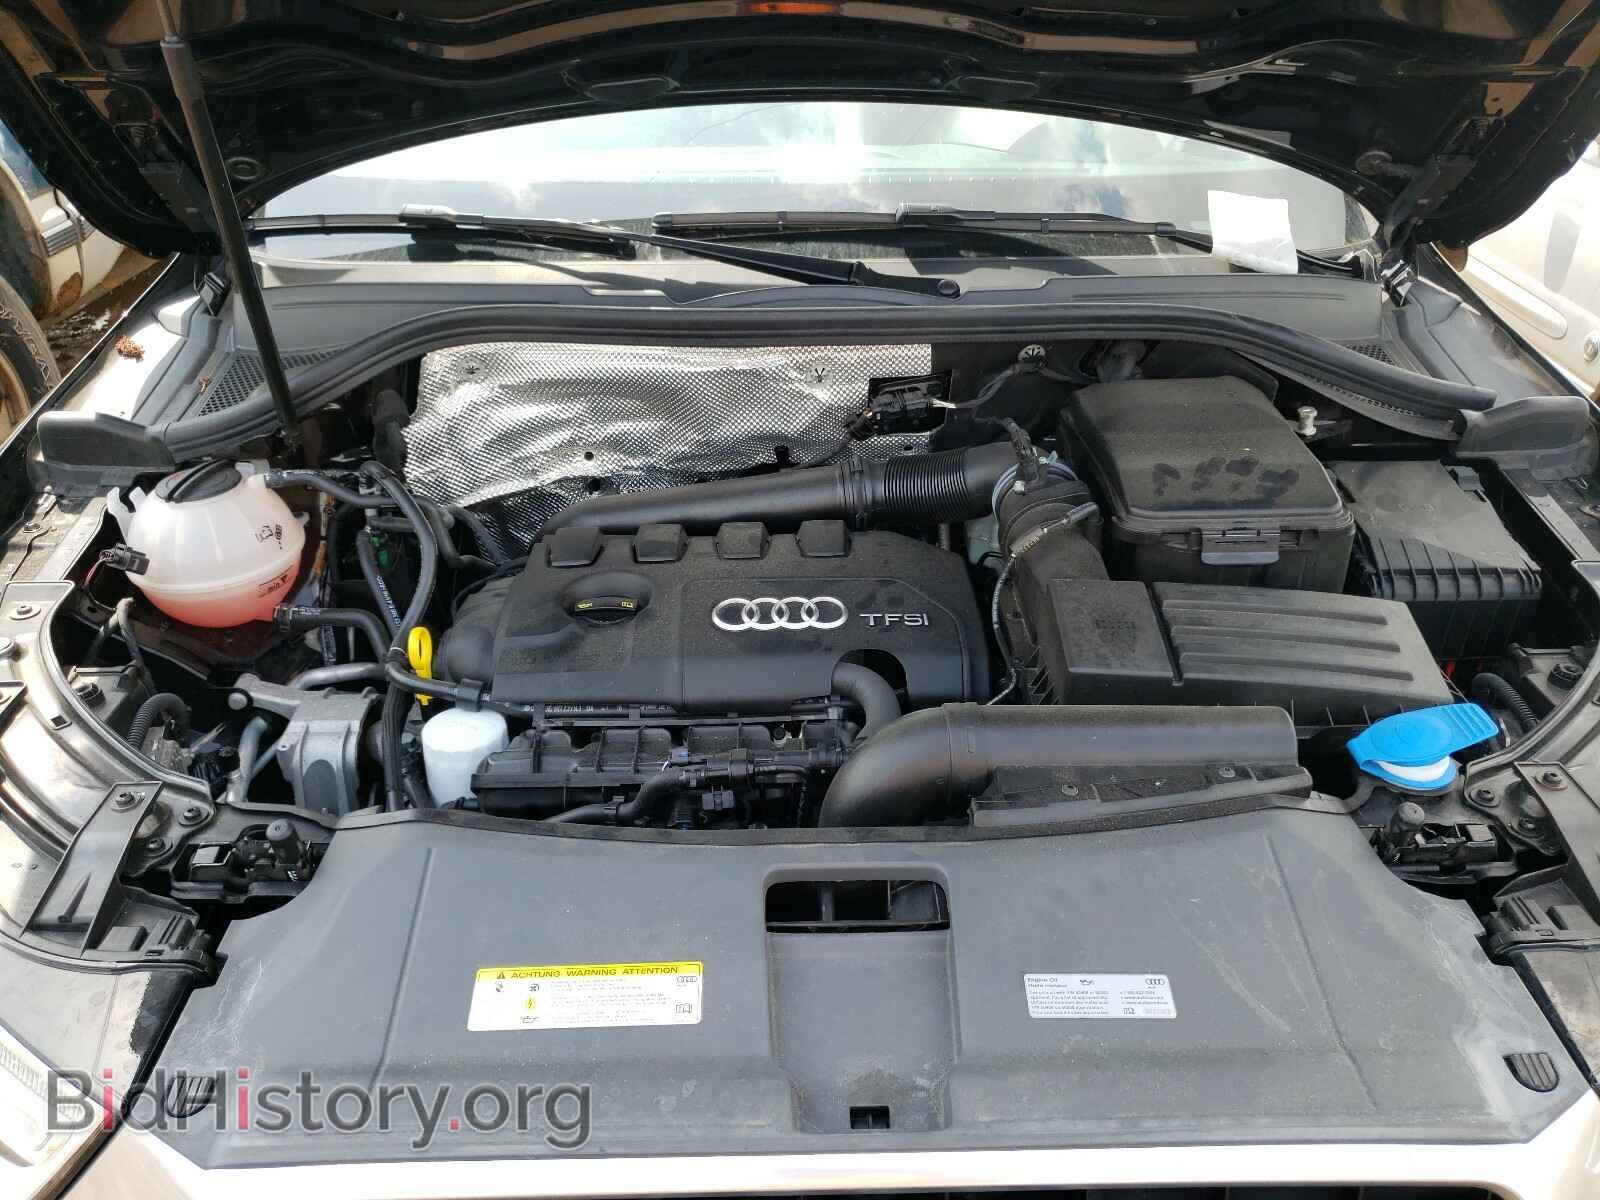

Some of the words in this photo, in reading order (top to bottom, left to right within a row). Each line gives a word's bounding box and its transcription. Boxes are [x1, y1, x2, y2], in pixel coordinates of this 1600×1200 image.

[859, 613, 929, 626] TFSI
[511, 969, 561, 979] ACHTUNG
[566, 967, 617, 977] WARNING
[622, 965, 679, 976] ATTENTION
